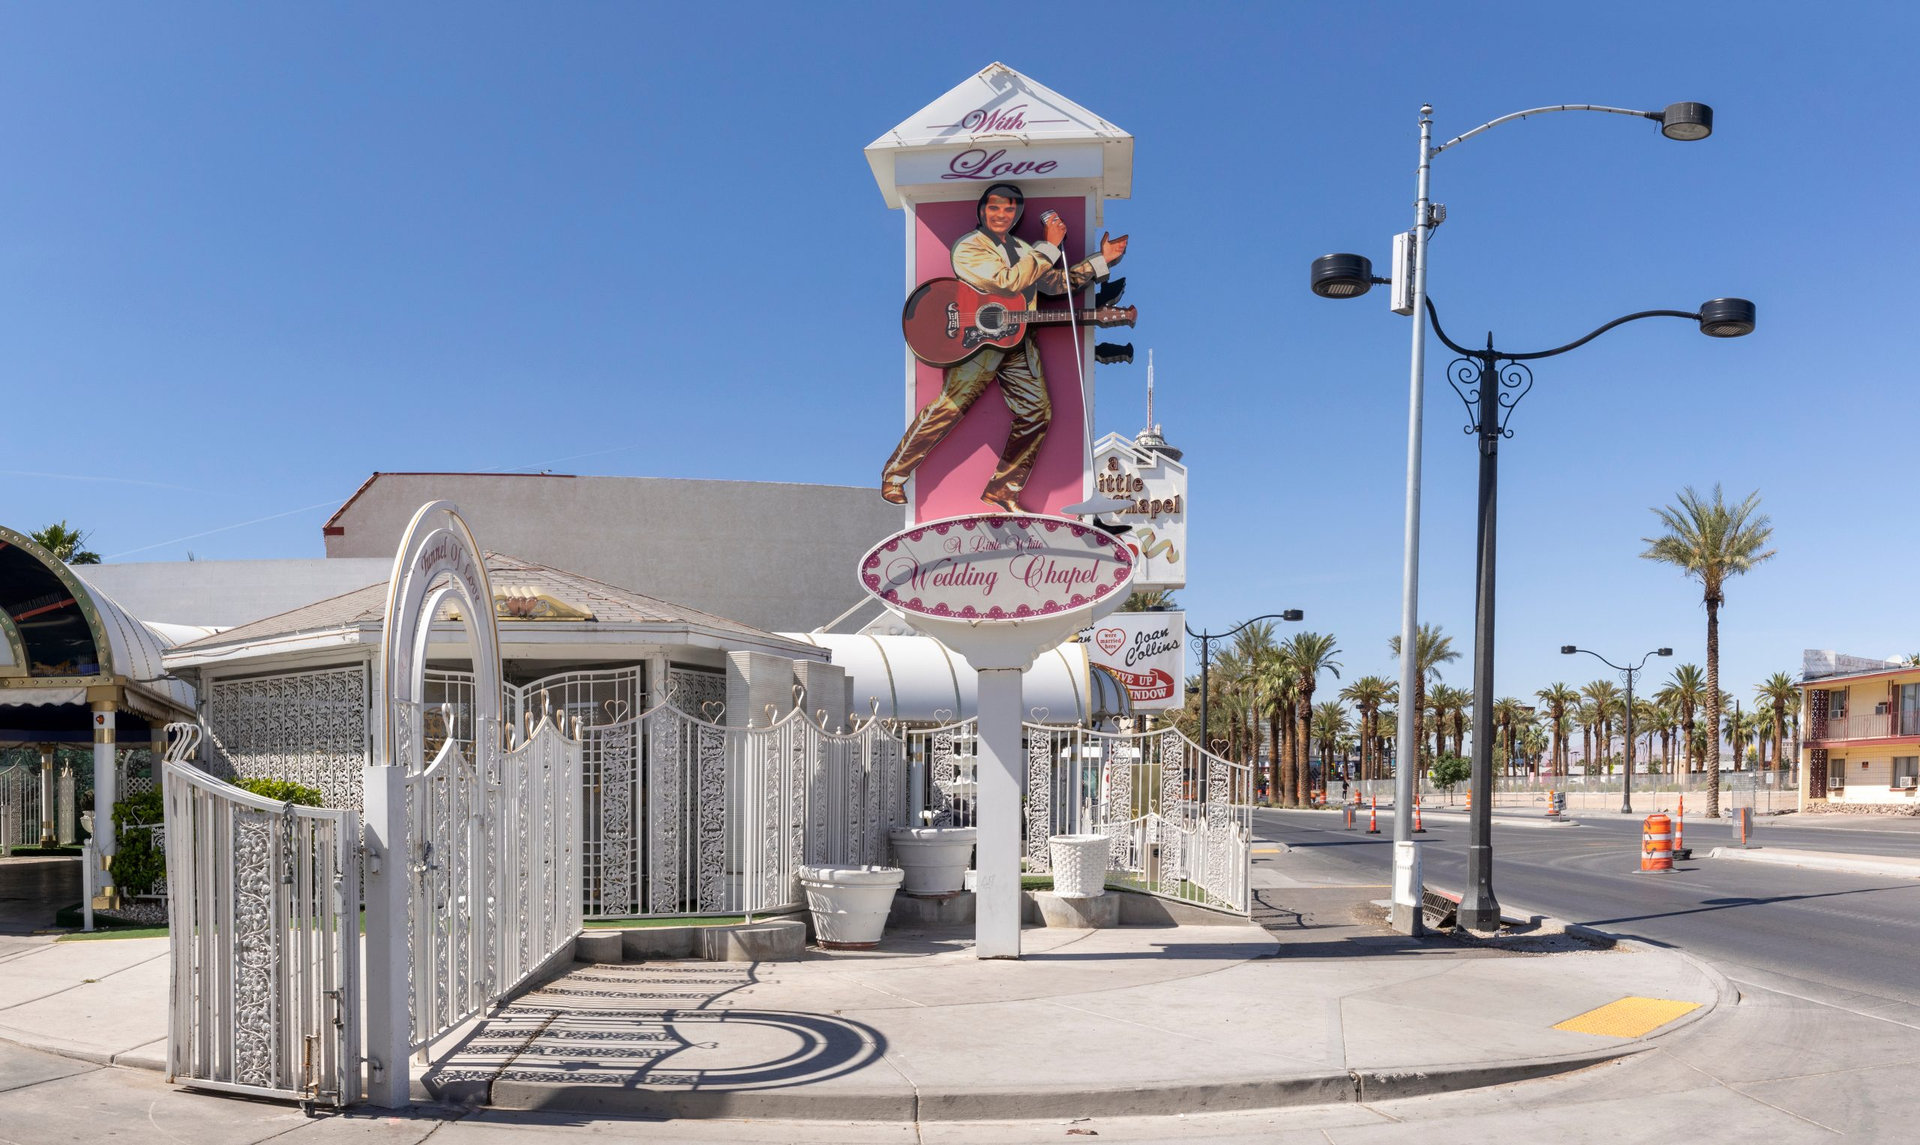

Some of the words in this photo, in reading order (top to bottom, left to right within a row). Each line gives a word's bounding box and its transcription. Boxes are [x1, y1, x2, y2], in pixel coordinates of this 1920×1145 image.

[962, 104, 1028, 133] With
[941, 149, 1058, 180] Love
[1107, 456, 1119, 471] a
[1098, 473, 1144, 493] ittle
[1112, 494, 1180, 519] hapel
[943, 536, 963, 555] A
[970, 535, 1001, 552] Little
[1006, 534, 1044, 551] White
[421, 536, 448, 577] Tunnel
[450, 543, 463, 571] Of
[464, 563, 480, 604] Love
[885, 556, 999, 596] Wedding
[1009, 553, 1099, 593] Chapel
[1135, 628, 1170, 652] Joan
[1125, 639, 1180, 667] Collins
[1117, 671, 1135, 684] IVE
[1139, 676, 1153, 686] UP
[1130, 688, 1167, 700] INDOW
